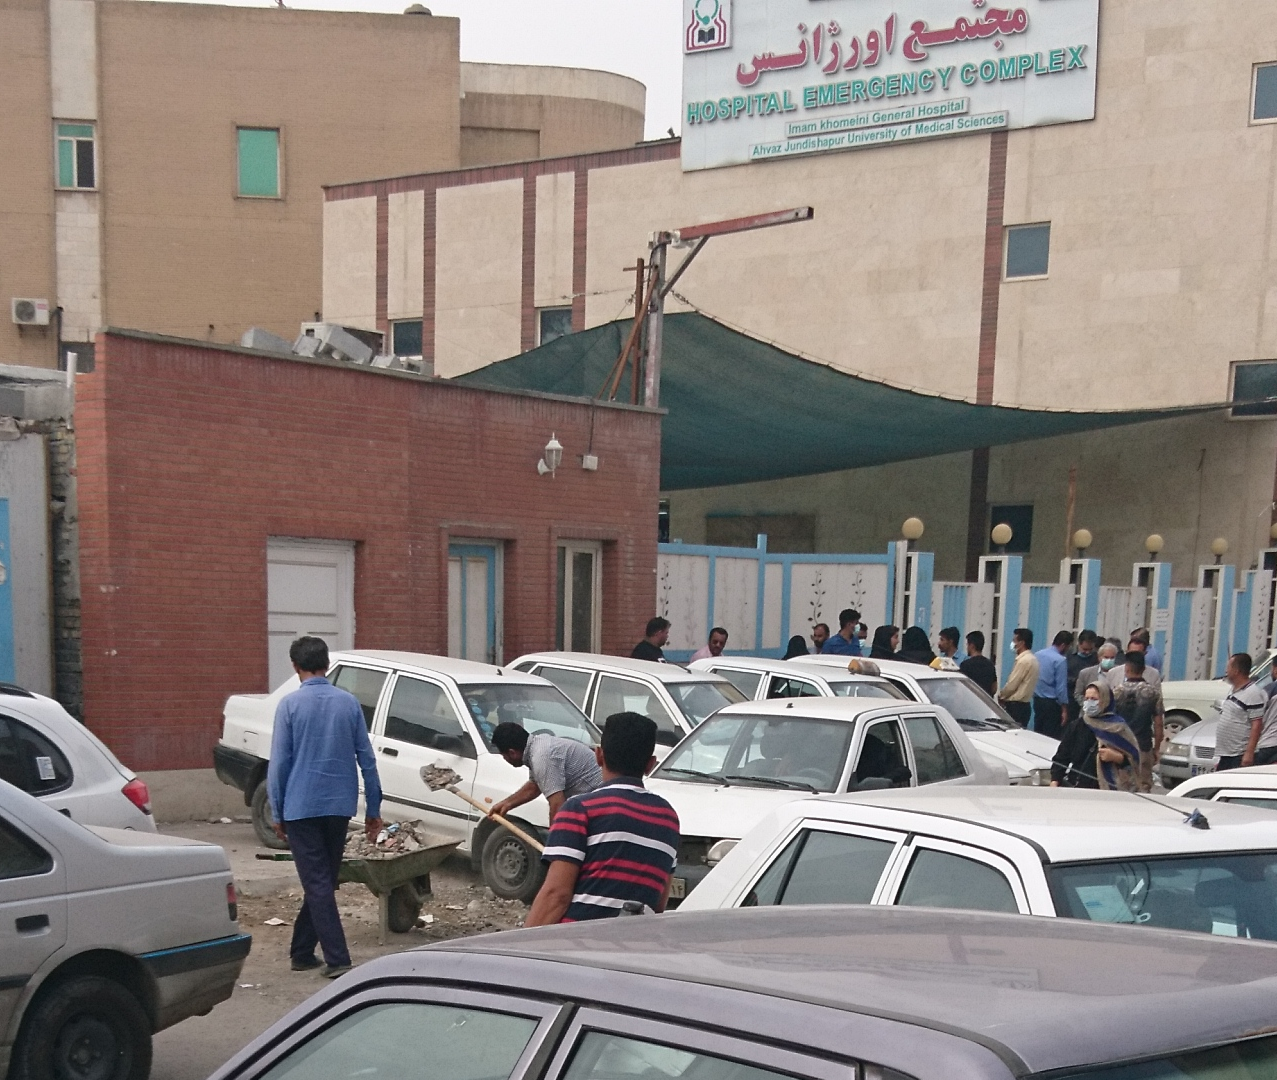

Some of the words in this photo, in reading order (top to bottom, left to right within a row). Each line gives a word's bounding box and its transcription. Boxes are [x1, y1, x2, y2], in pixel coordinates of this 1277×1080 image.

[736, 12, 897, 87] اورژانس
[903, 0, 1028, 61] مجتمع
[687, 90, 795, 124] HOSPITAL
[803, 66, 954, 109] EMERGENCY
[960, 44, 1086, 86] COMPLEX
[753, 144, 782, 156] Ahvaz
[785, 135, 845, 153] Jundishapur
[847, 127, 898, 143] University
[901, 125, 912, 137] of
[915, 118, 955, 134] Medical
[957, 113, 1005, 129] Sciences
[788, 122, 817, 135] Imam
[820, 114, 869, 131] khomeini
[872, 107, 915, 123] General
[918, 99, 965, 116] Hospital
